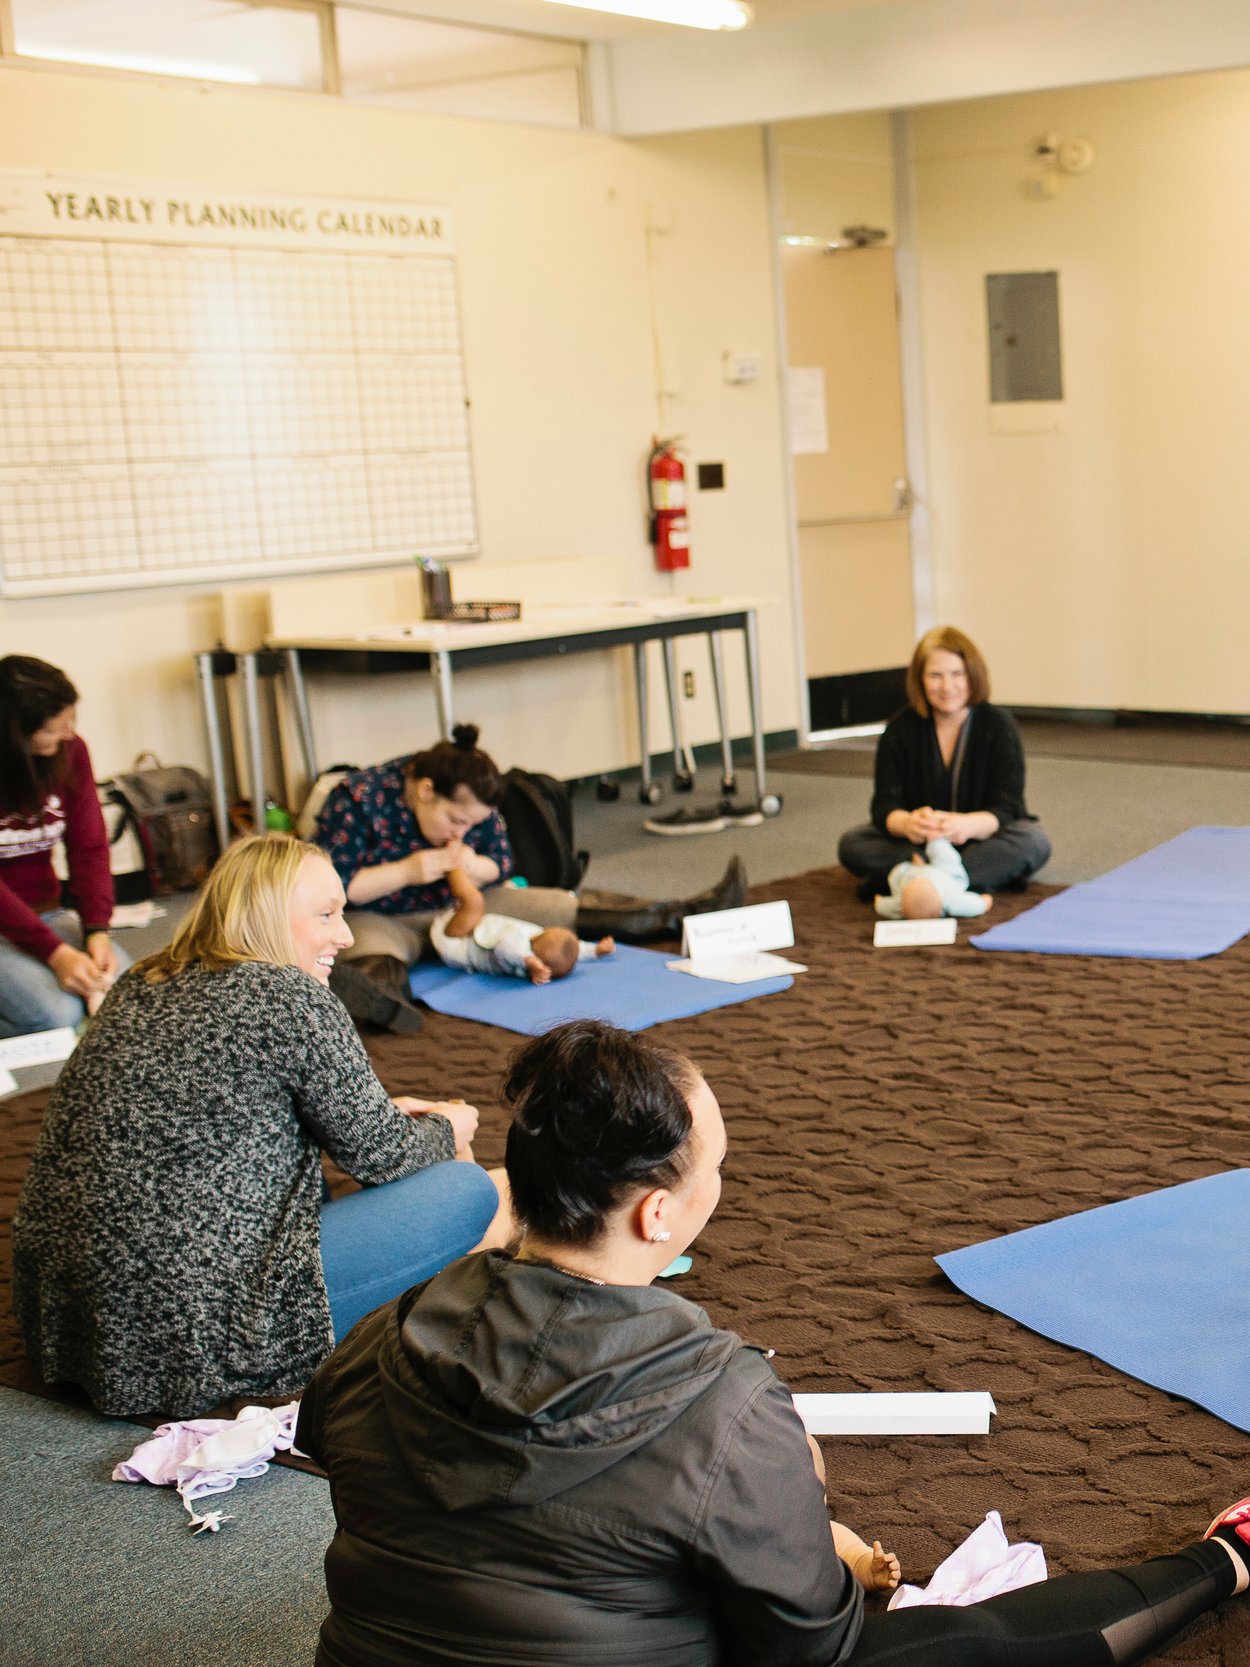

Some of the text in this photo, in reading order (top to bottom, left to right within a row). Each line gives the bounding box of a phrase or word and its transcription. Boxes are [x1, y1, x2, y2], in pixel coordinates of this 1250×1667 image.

[46, 190, 445, 240] YEARLY PLANNING CALENDAR
